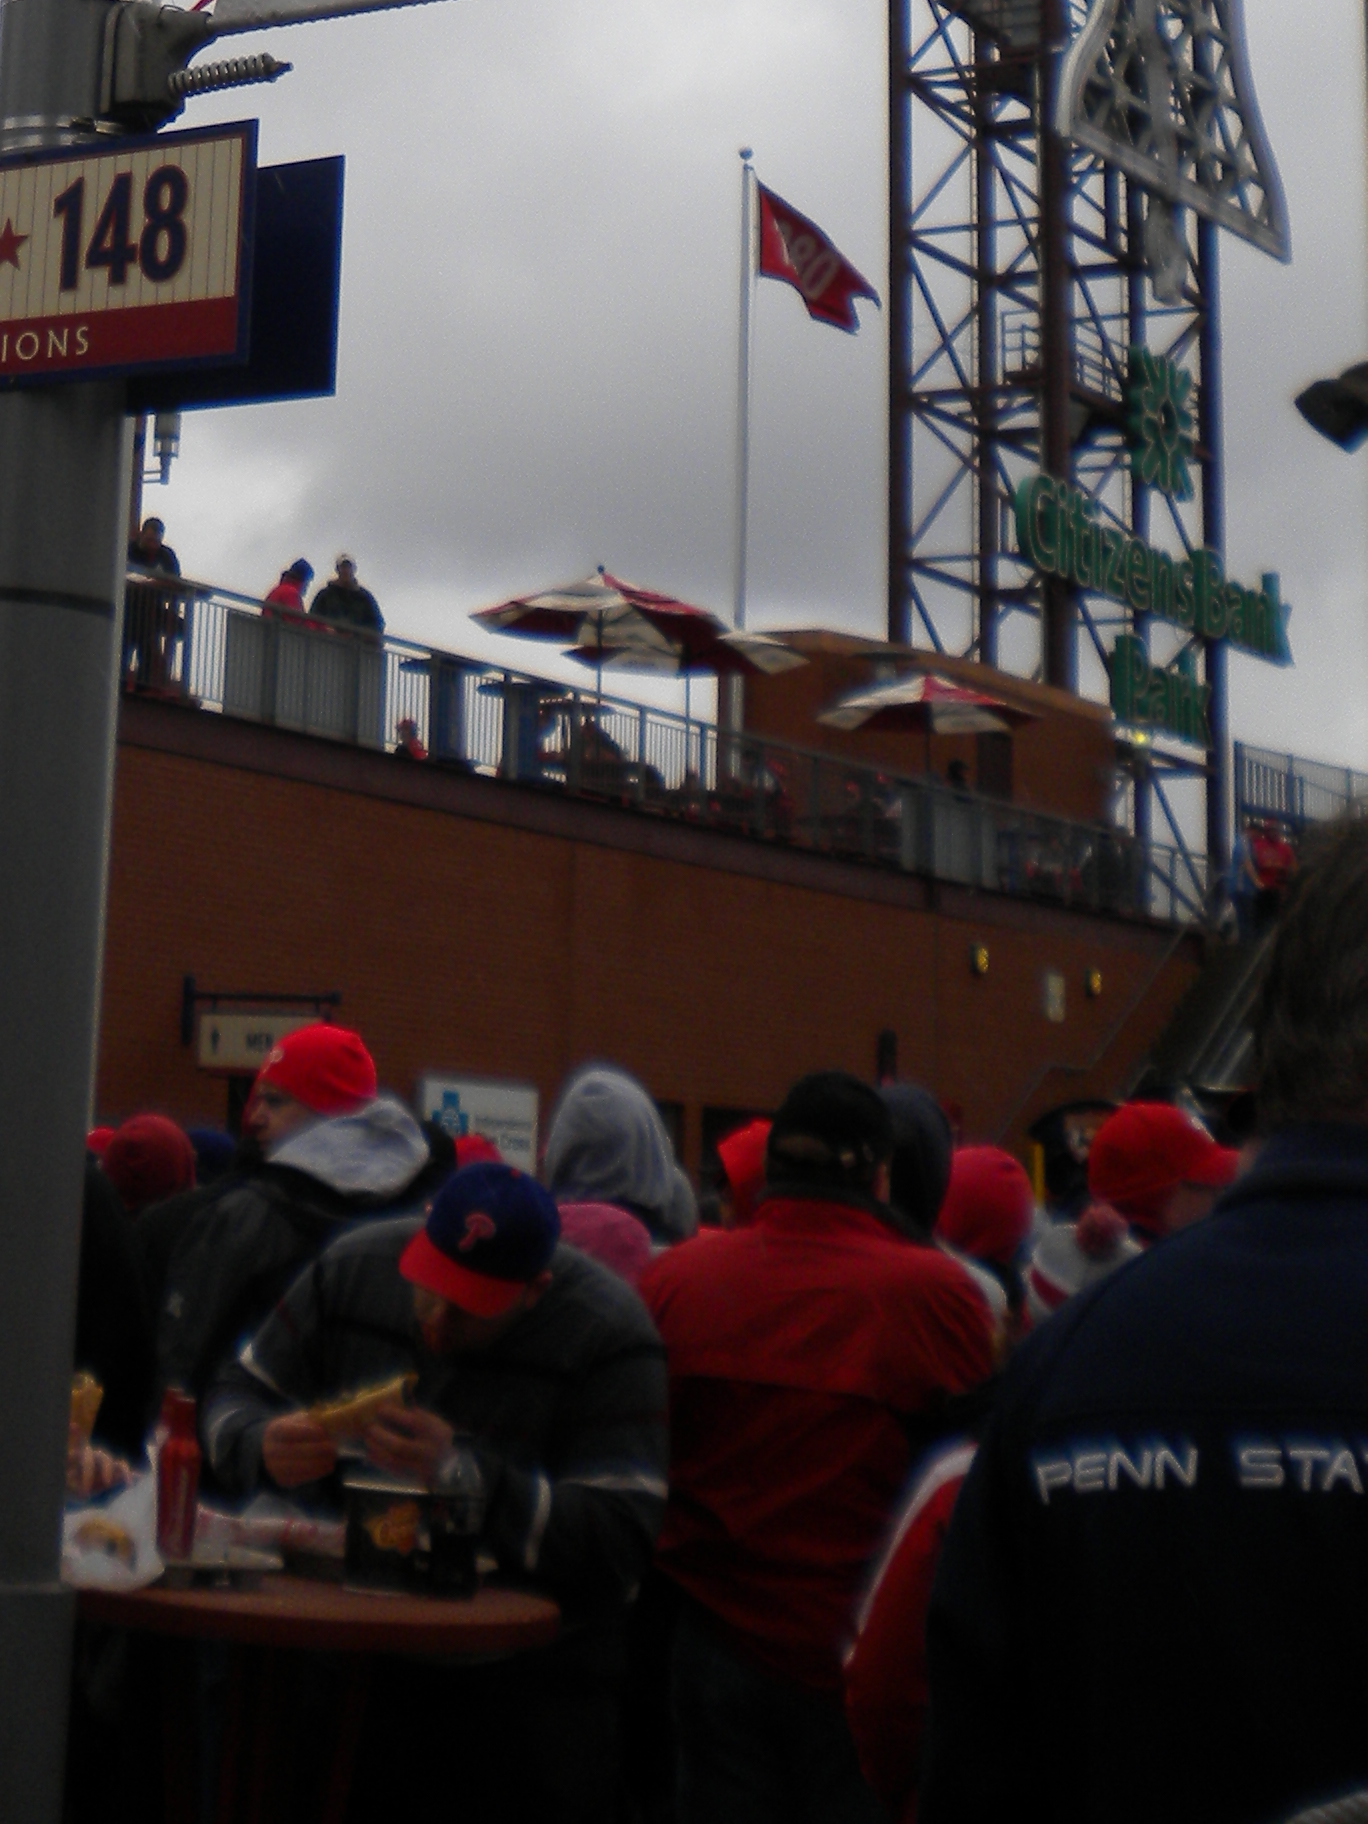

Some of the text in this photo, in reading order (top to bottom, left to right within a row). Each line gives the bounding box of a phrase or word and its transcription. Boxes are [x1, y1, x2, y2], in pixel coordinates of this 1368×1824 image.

[52, 164, 190, 292] 148
[1015, 473, 1196, 631] Citizens
[1036, 1447, 1199, 1506] PENN
